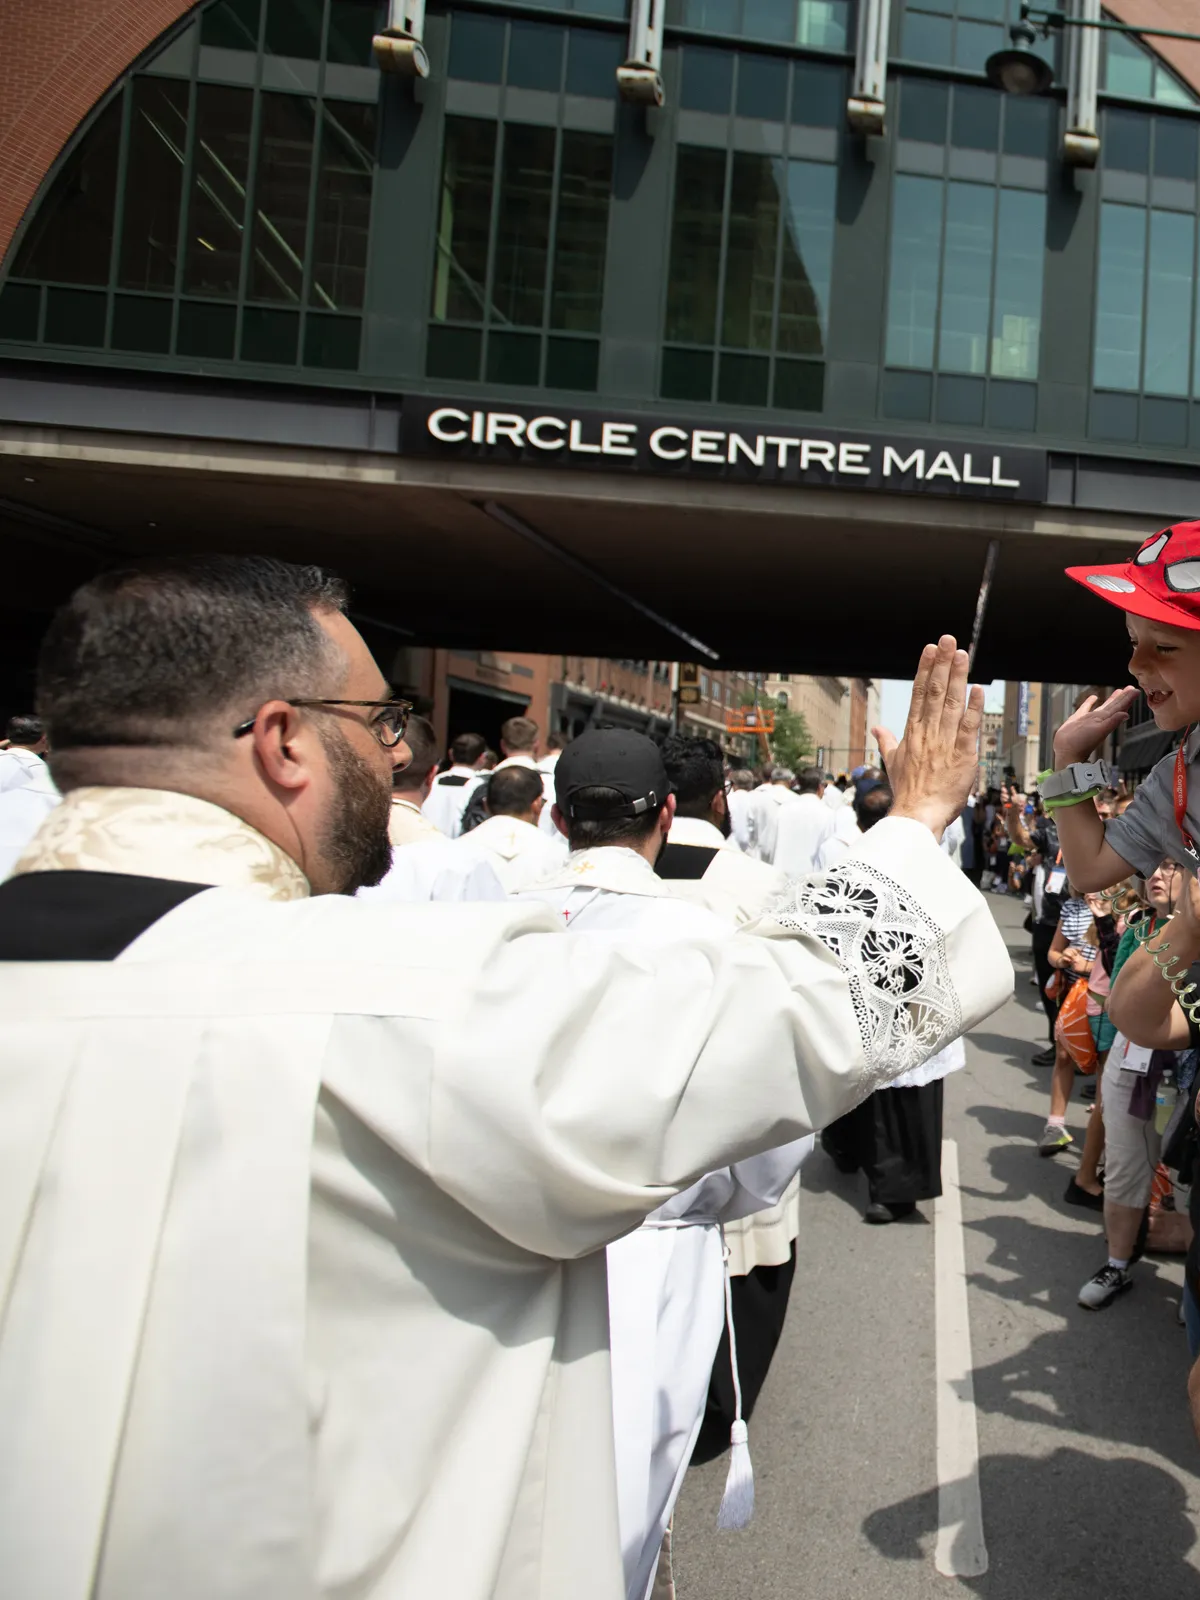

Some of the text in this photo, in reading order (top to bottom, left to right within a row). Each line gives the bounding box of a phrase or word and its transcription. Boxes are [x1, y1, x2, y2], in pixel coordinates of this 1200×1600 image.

[427, 407, 1021, 488] CIRCLE CENTRE MALL
[1176, 774, 1184, 806] Congress
